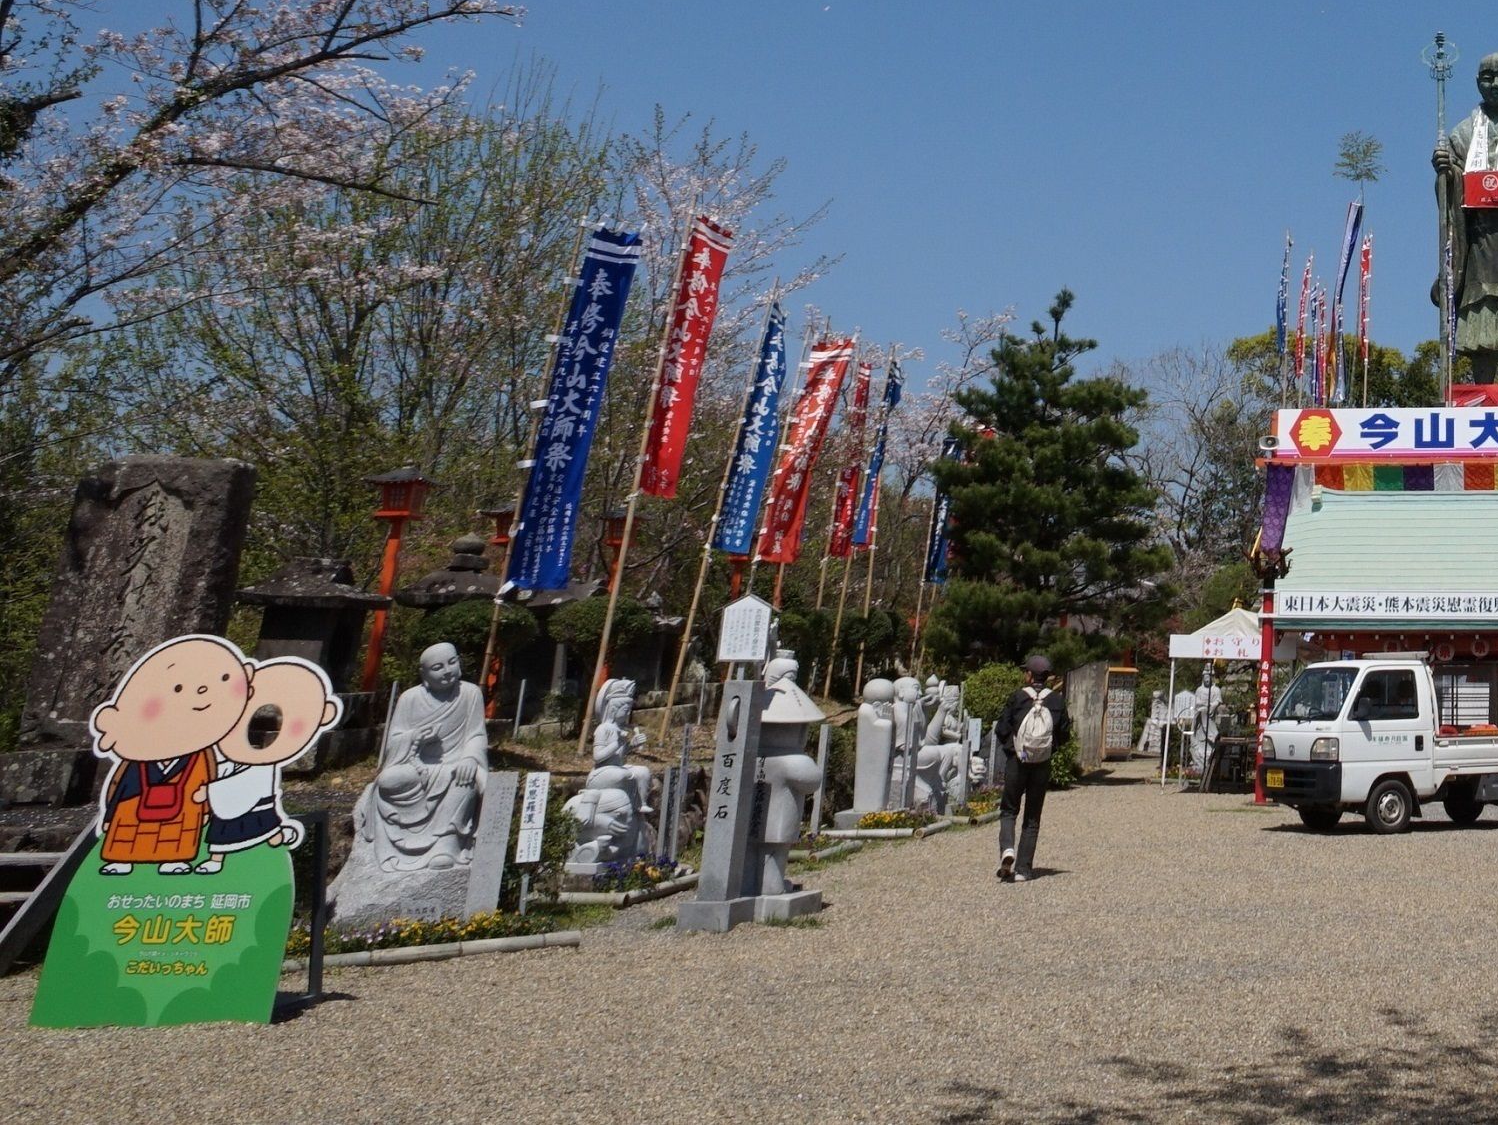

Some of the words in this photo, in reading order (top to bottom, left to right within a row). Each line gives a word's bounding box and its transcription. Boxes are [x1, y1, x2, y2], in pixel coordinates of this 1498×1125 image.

[544, 268, 614, 472] 奉修今山大師祭
[1299, 415, 1332, 448] 奉
[714, 753, 737, 820] 百度石
[107, 894, 205, 909] おせったいのまち
[210, 894, 251, 910] 延岡市
[113, 914, 236, 945] 今山大師
[126, 961, 208, 976] こだいっちゃん
